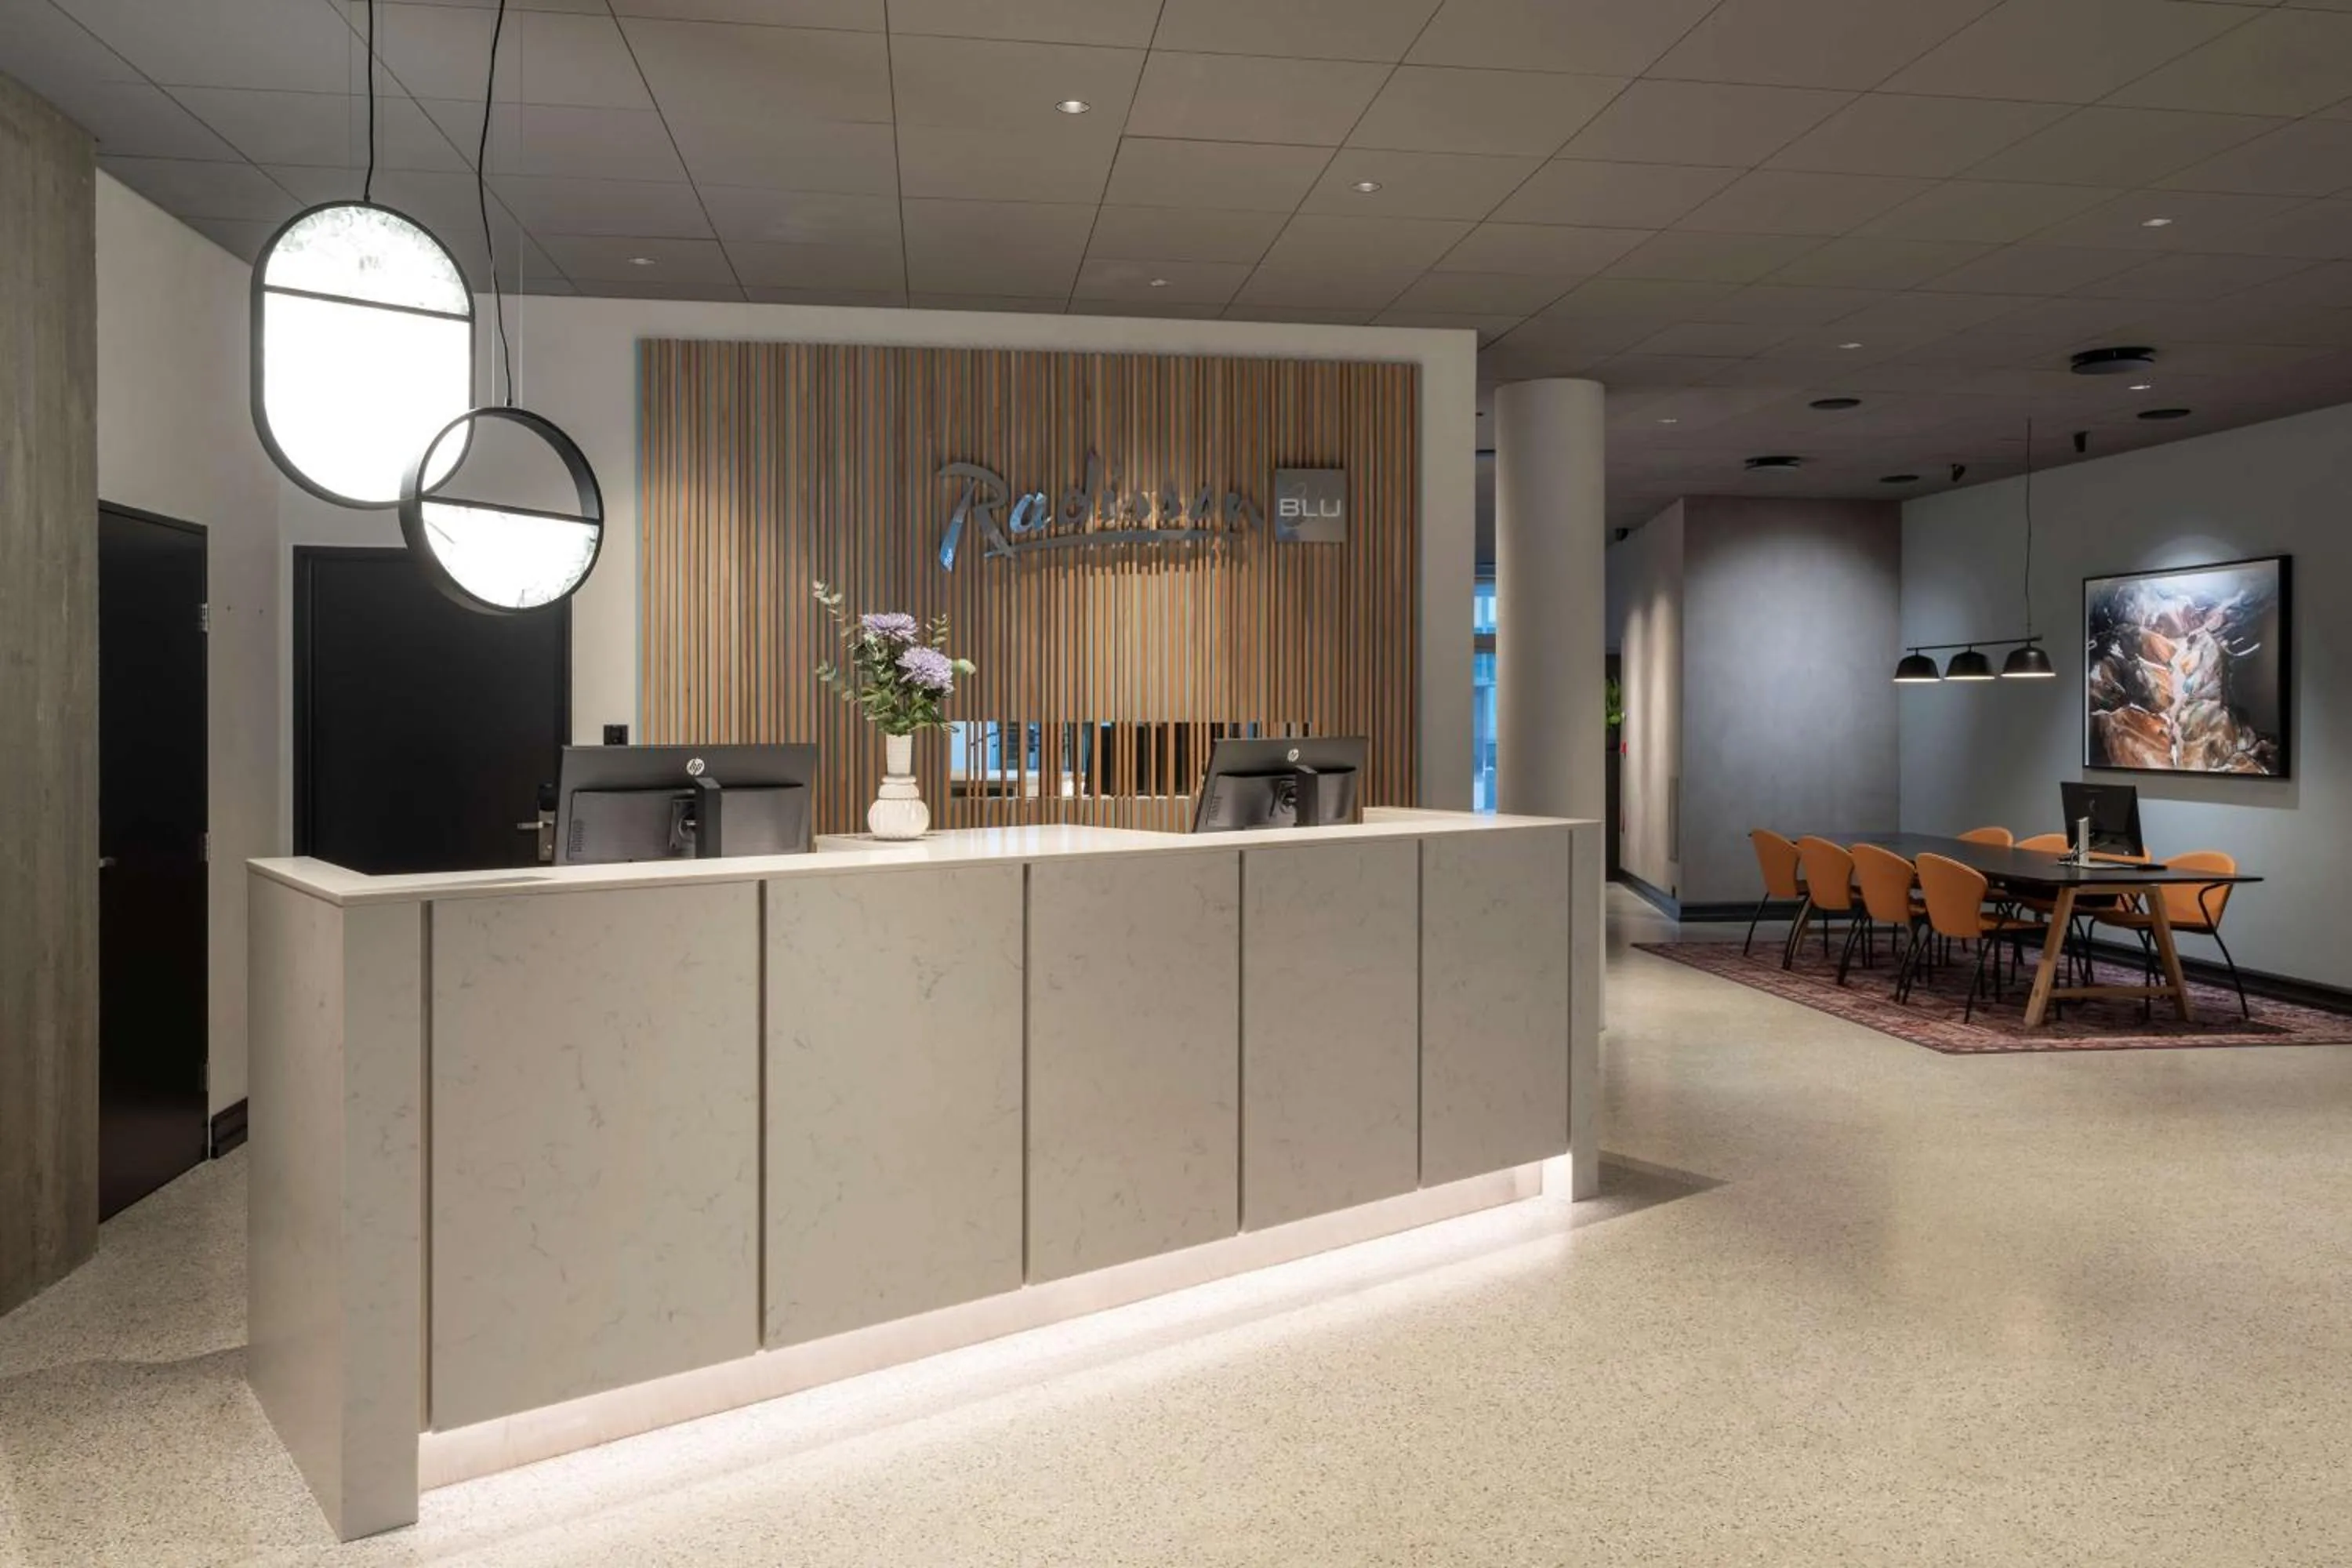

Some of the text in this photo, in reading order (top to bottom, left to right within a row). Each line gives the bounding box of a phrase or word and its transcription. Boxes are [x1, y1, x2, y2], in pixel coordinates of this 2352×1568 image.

[938, 448, 1341, 573] Radisson BLU
[688, 758, 704, 775] hp
